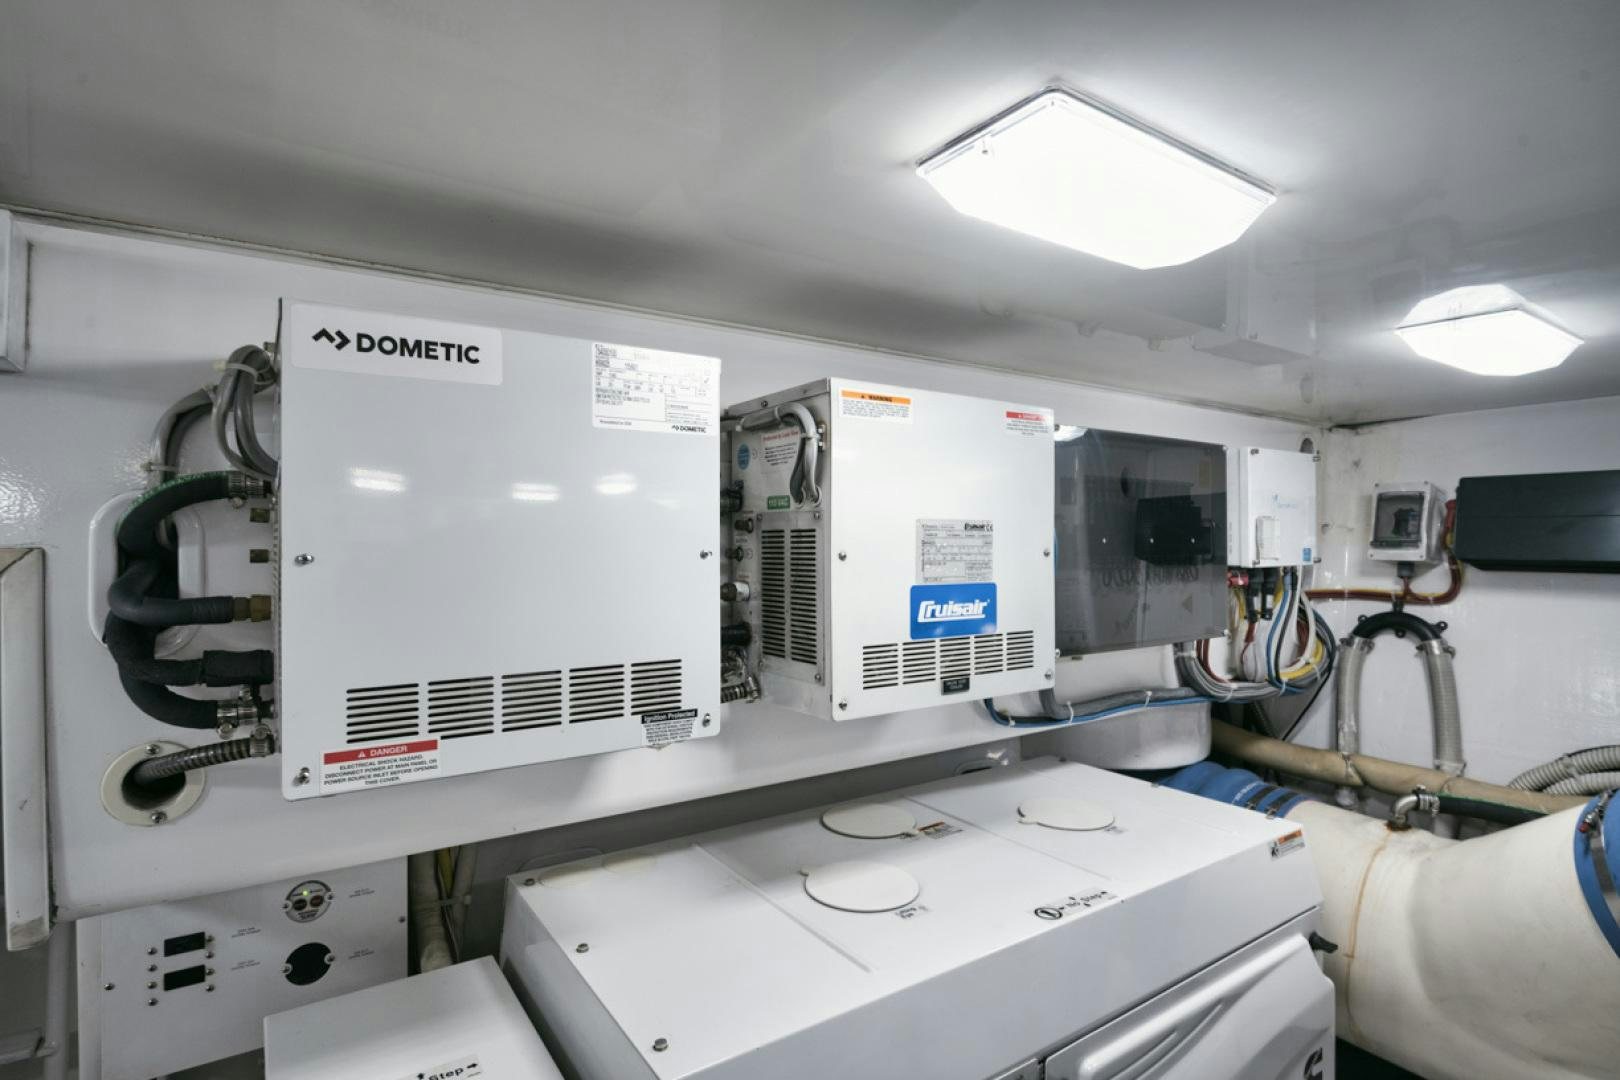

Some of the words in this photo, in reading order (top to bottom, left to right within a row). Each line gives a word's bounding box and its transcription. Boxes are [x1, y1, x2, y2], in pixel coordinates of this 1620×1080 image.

[356, 333, 480, 364] DOMETIC
[917, 599, 988, 622] Cruisair
[370, 745, 408, 757] DANGER
[325, 769, 364, 779] DISCONNECT
[365, 766, 386, 775] POWER
[395, 762, 410, 770] MAIN
[339, 761, 376, 771] ELECTRICAL
[377, 758, 398, 766] SHOCK
[323, 777, 346, 786] POWER
